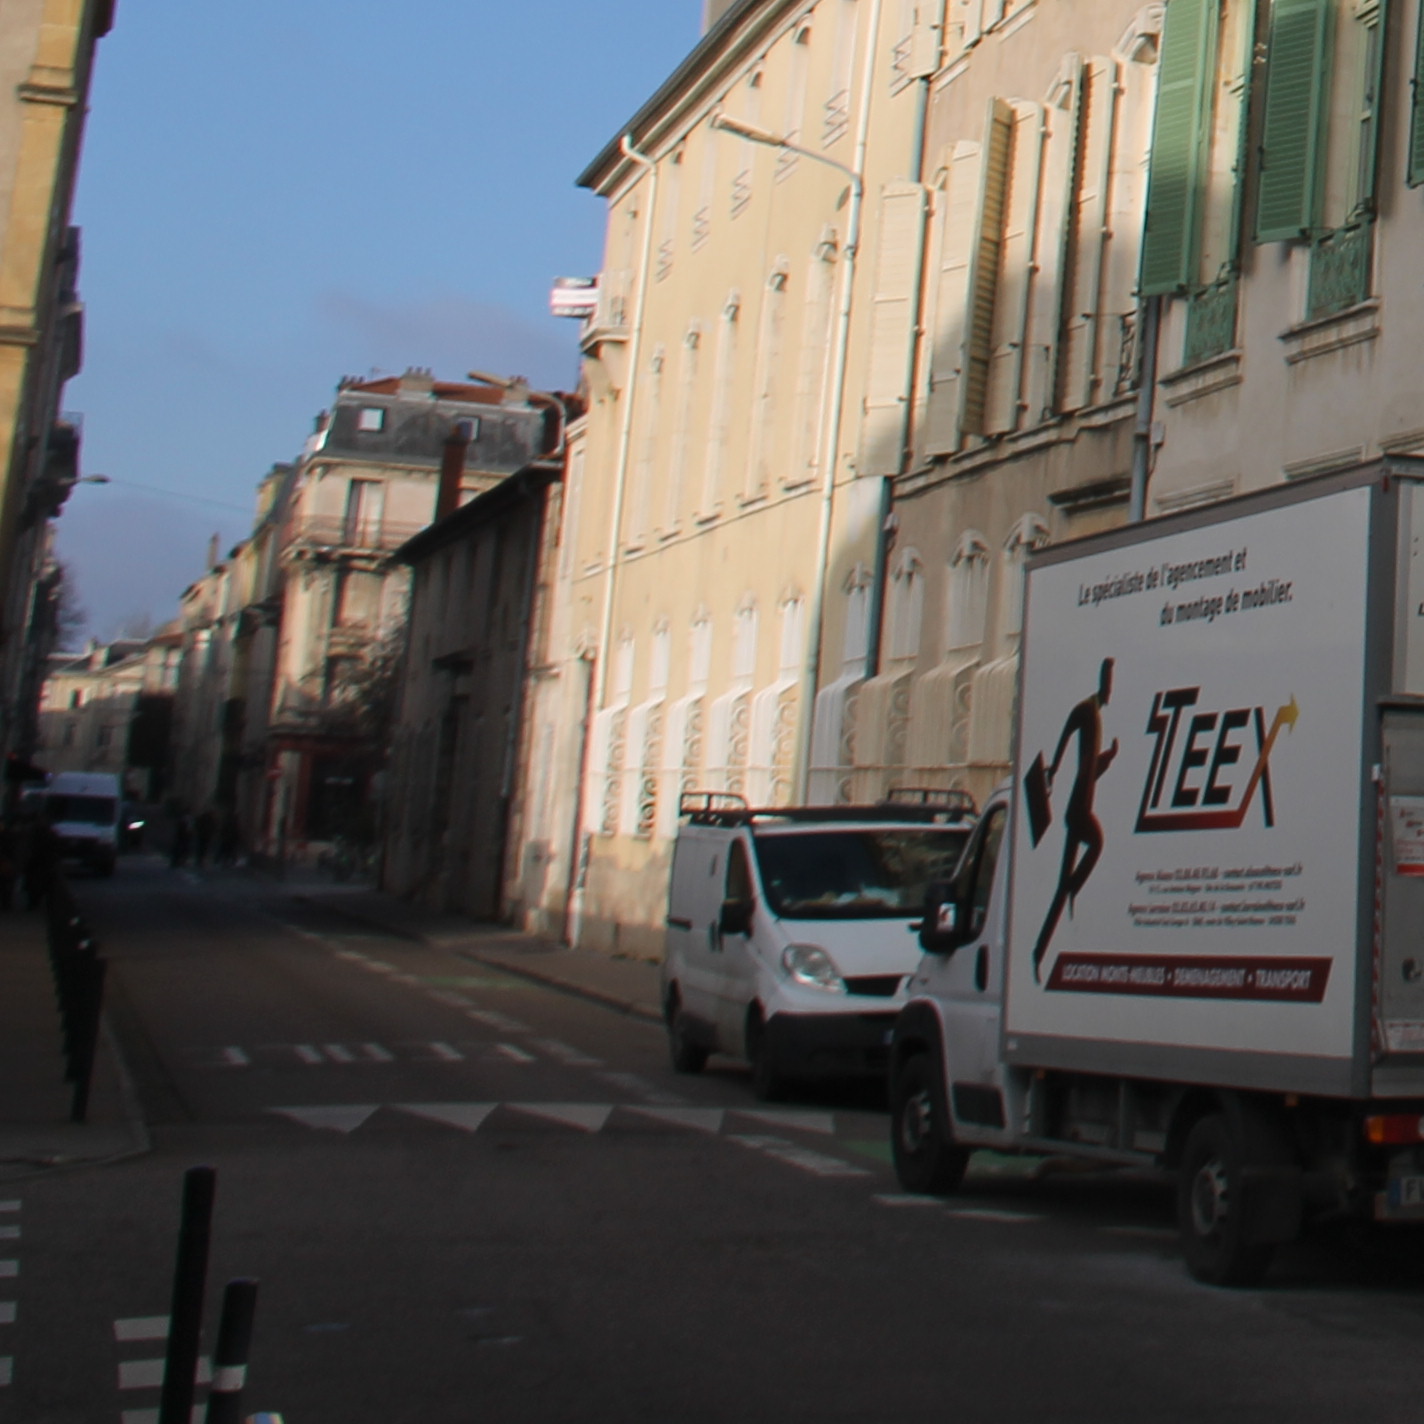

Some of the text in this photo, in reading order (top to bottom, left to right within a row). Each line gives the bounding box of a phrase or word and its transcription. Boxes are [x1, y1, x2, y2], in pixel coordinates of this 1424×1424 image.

[1077, 547, 1247, 608] Le spécialiste de l'agencement et
[1160, 602, 1174, 627] du
[1175, 592, 1223, 623] montage
[1225, 589, 1239, 613] de
